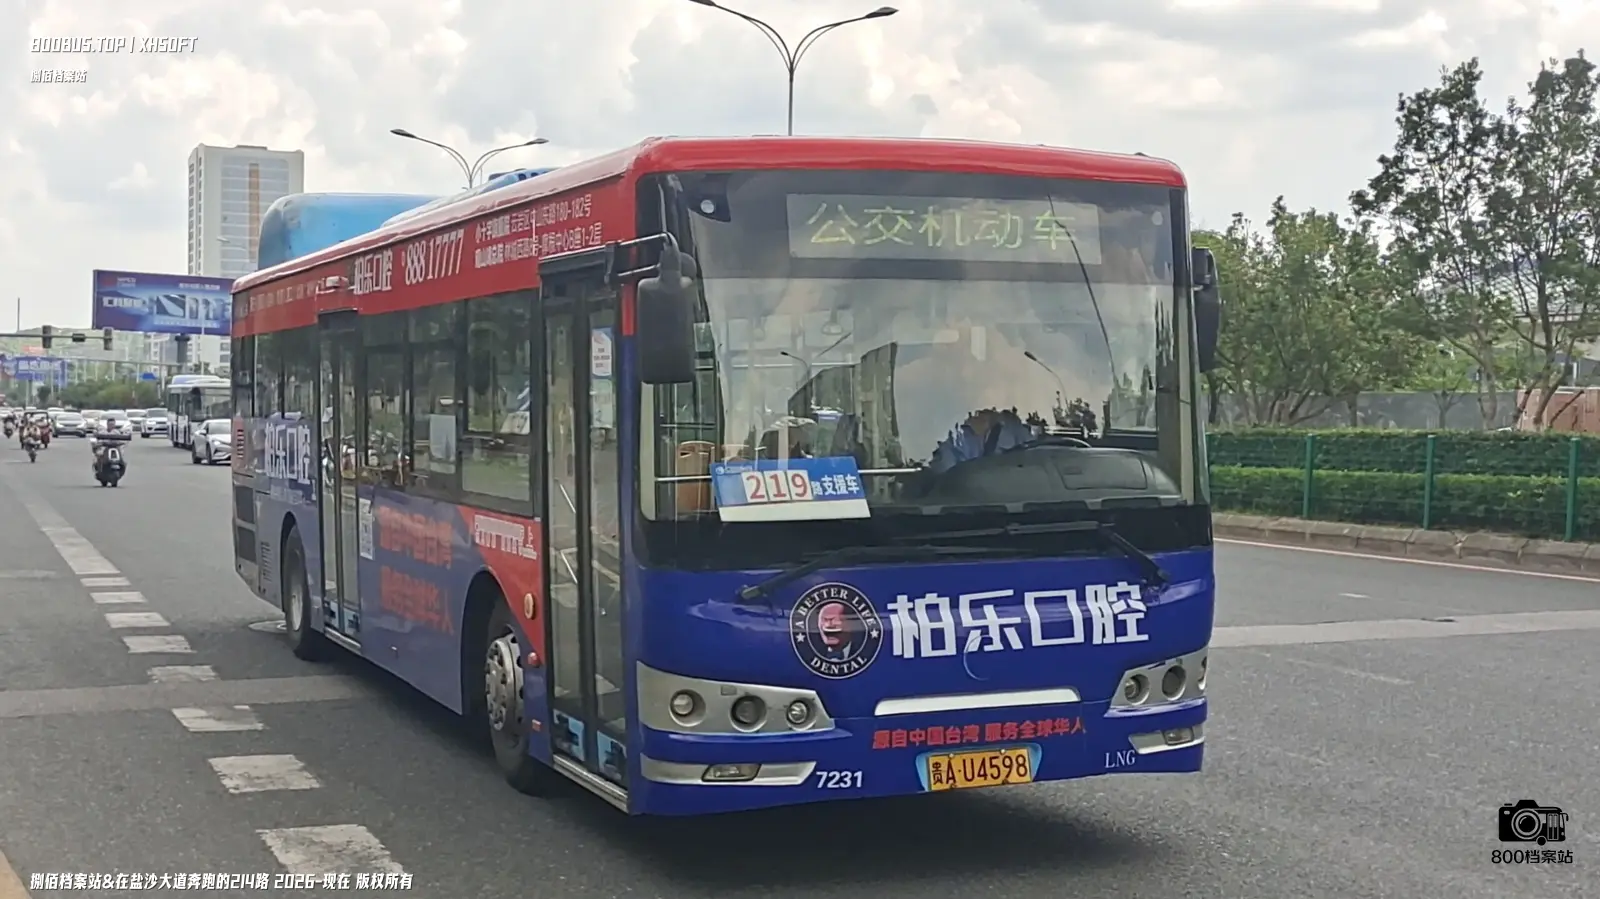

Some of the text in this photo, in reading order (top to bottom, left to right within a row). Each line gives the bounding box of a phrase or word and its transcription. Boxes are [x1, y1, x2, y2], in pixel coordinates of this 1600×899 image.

[806, 203, 1076, 250] 公交机动车
[795, 587, 877, 629] A BETTER LIFE
[887, 581, 1150, 660] 柏乐口腔
[810, 655, 868, 675] DENTAL
[872, 716, 1088, 749] 源自中国台湾 服务全球华人
[1104, 750, 1136, 769] LNG
[816, 770, 863, 789] 7231
